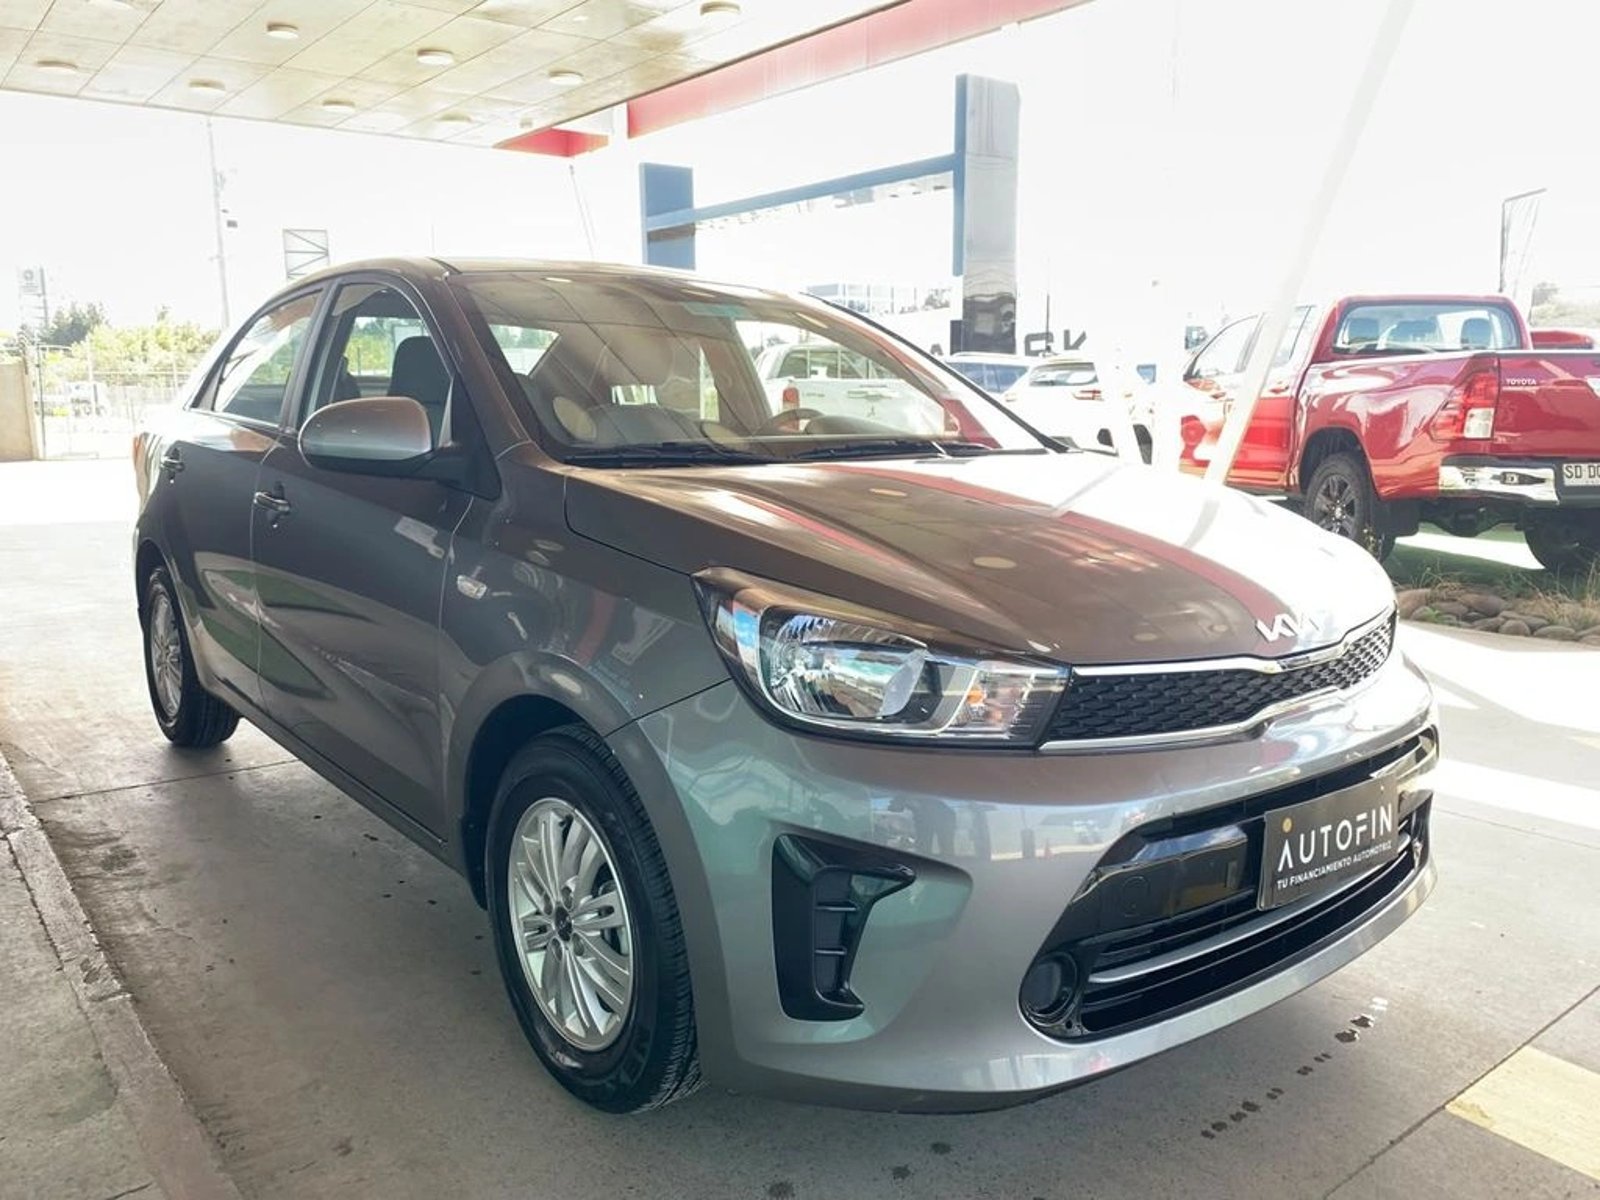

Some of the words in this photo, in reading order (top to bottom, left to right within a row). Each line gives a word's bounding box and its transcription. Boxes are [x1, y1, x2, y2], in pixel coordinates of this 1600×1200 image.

[1505, 377, 1537, 386] TOYOTA
[1277, 803, 1393, 872] AUTOFIN
[1276, 877, 1289, 891] TU
[1289, 855, 1352, 886] FINANCIAMIENTO
[1352, 839, 1393, 864] AUTOMOTRIZ
